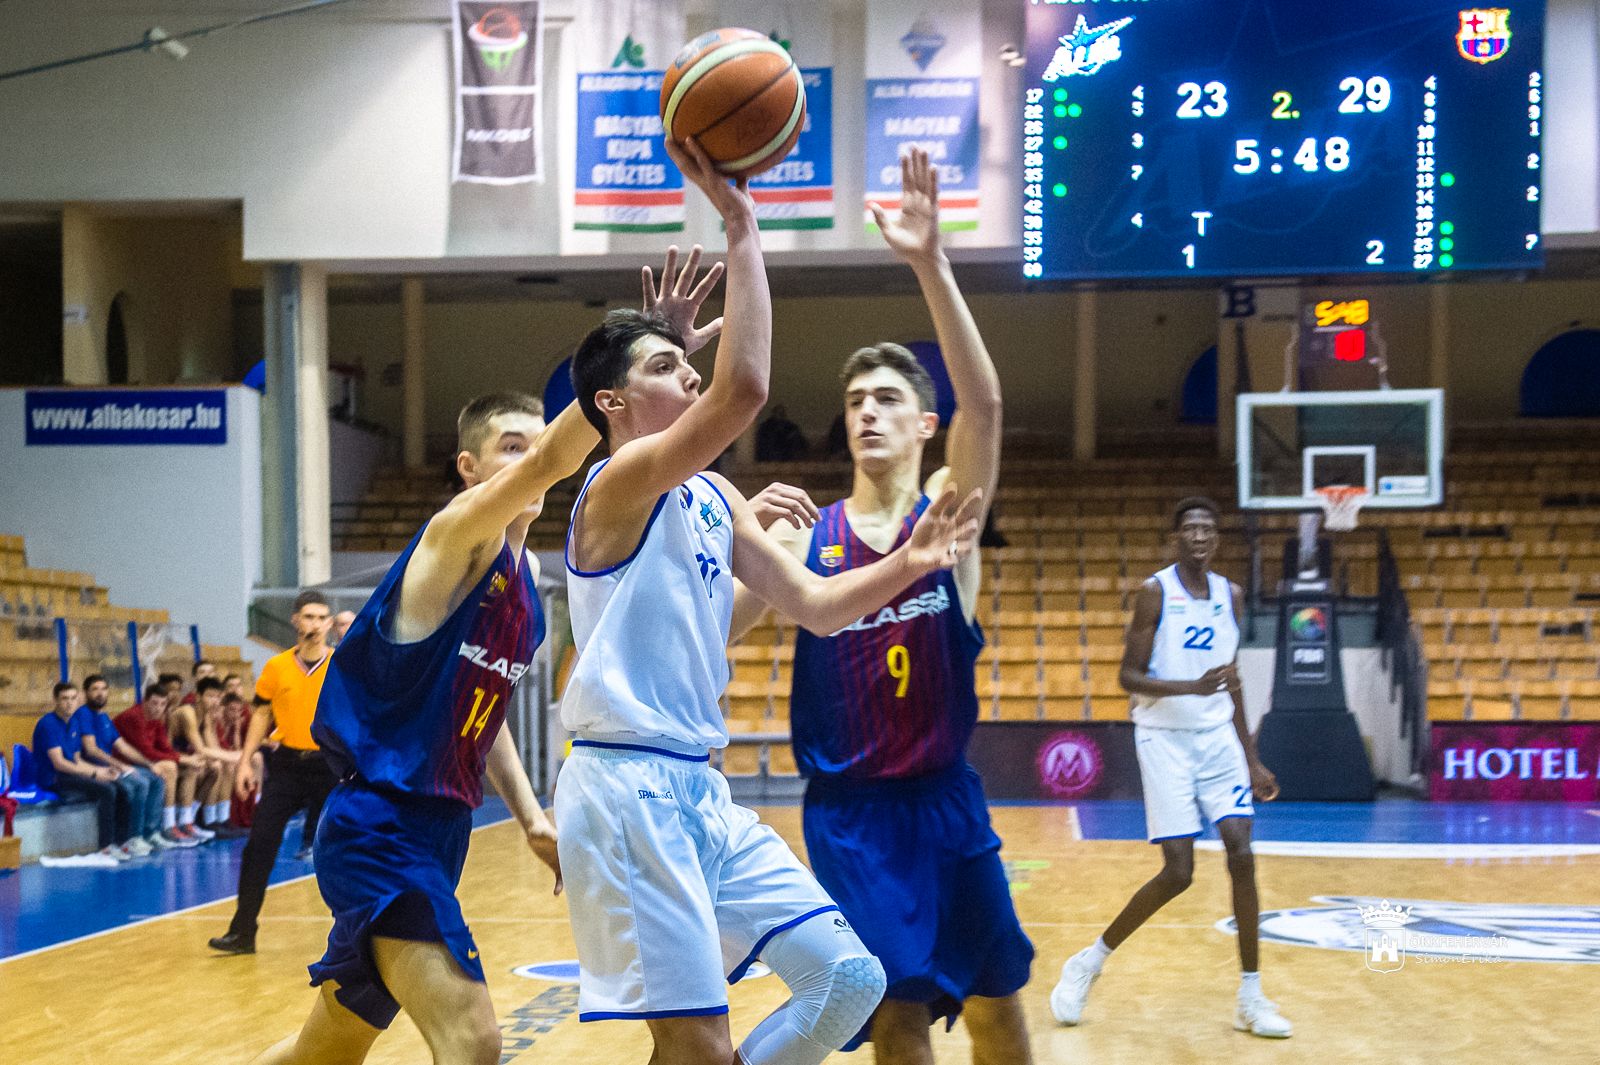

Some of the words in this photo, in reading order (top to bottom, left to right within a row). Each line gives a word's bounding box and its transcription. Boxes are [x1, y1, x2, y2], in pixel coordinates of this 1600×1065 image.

[1423, 75, 1437, 91] 4
[1528, 71, 1541, 88] 2
[1176, 81, 1229, 119] 23
[1271, 91, 1300, 119] 2.
[1338, 76, 1391, 114] 29
[1529, 120, 1540, 137] 1
[1131, 132, 1145, 149] 3
[1416, 141, 1434, 156] 11
[1233, 136, 1350, 175] 5:48
[1416, 157, 1435, 172] 12
[1527, 152, 1540, 170] 2
[1131, 164, 1144, 181] 7
[1024, 184, 1043, 198] 41
[1416, 189, 1434, 205] 14
[1526, 186, 1539, 202] 2
[1191, 211, 1213, 237] T
[1415, 221, 1433, 237] 17
[1525, 234, 1538, 250] 7
[1182, 244, 1196, 269] 1
[1365, 239, 1385, 265] 2
[31, 402, 222, 431] www.albakosar.hu
[1183, 625, 1215, 651] 22
[886, 644, 911, 698] 9
[460, 686, 500, 741] 14
[1443, 747, 1589, 781] HOTEL
